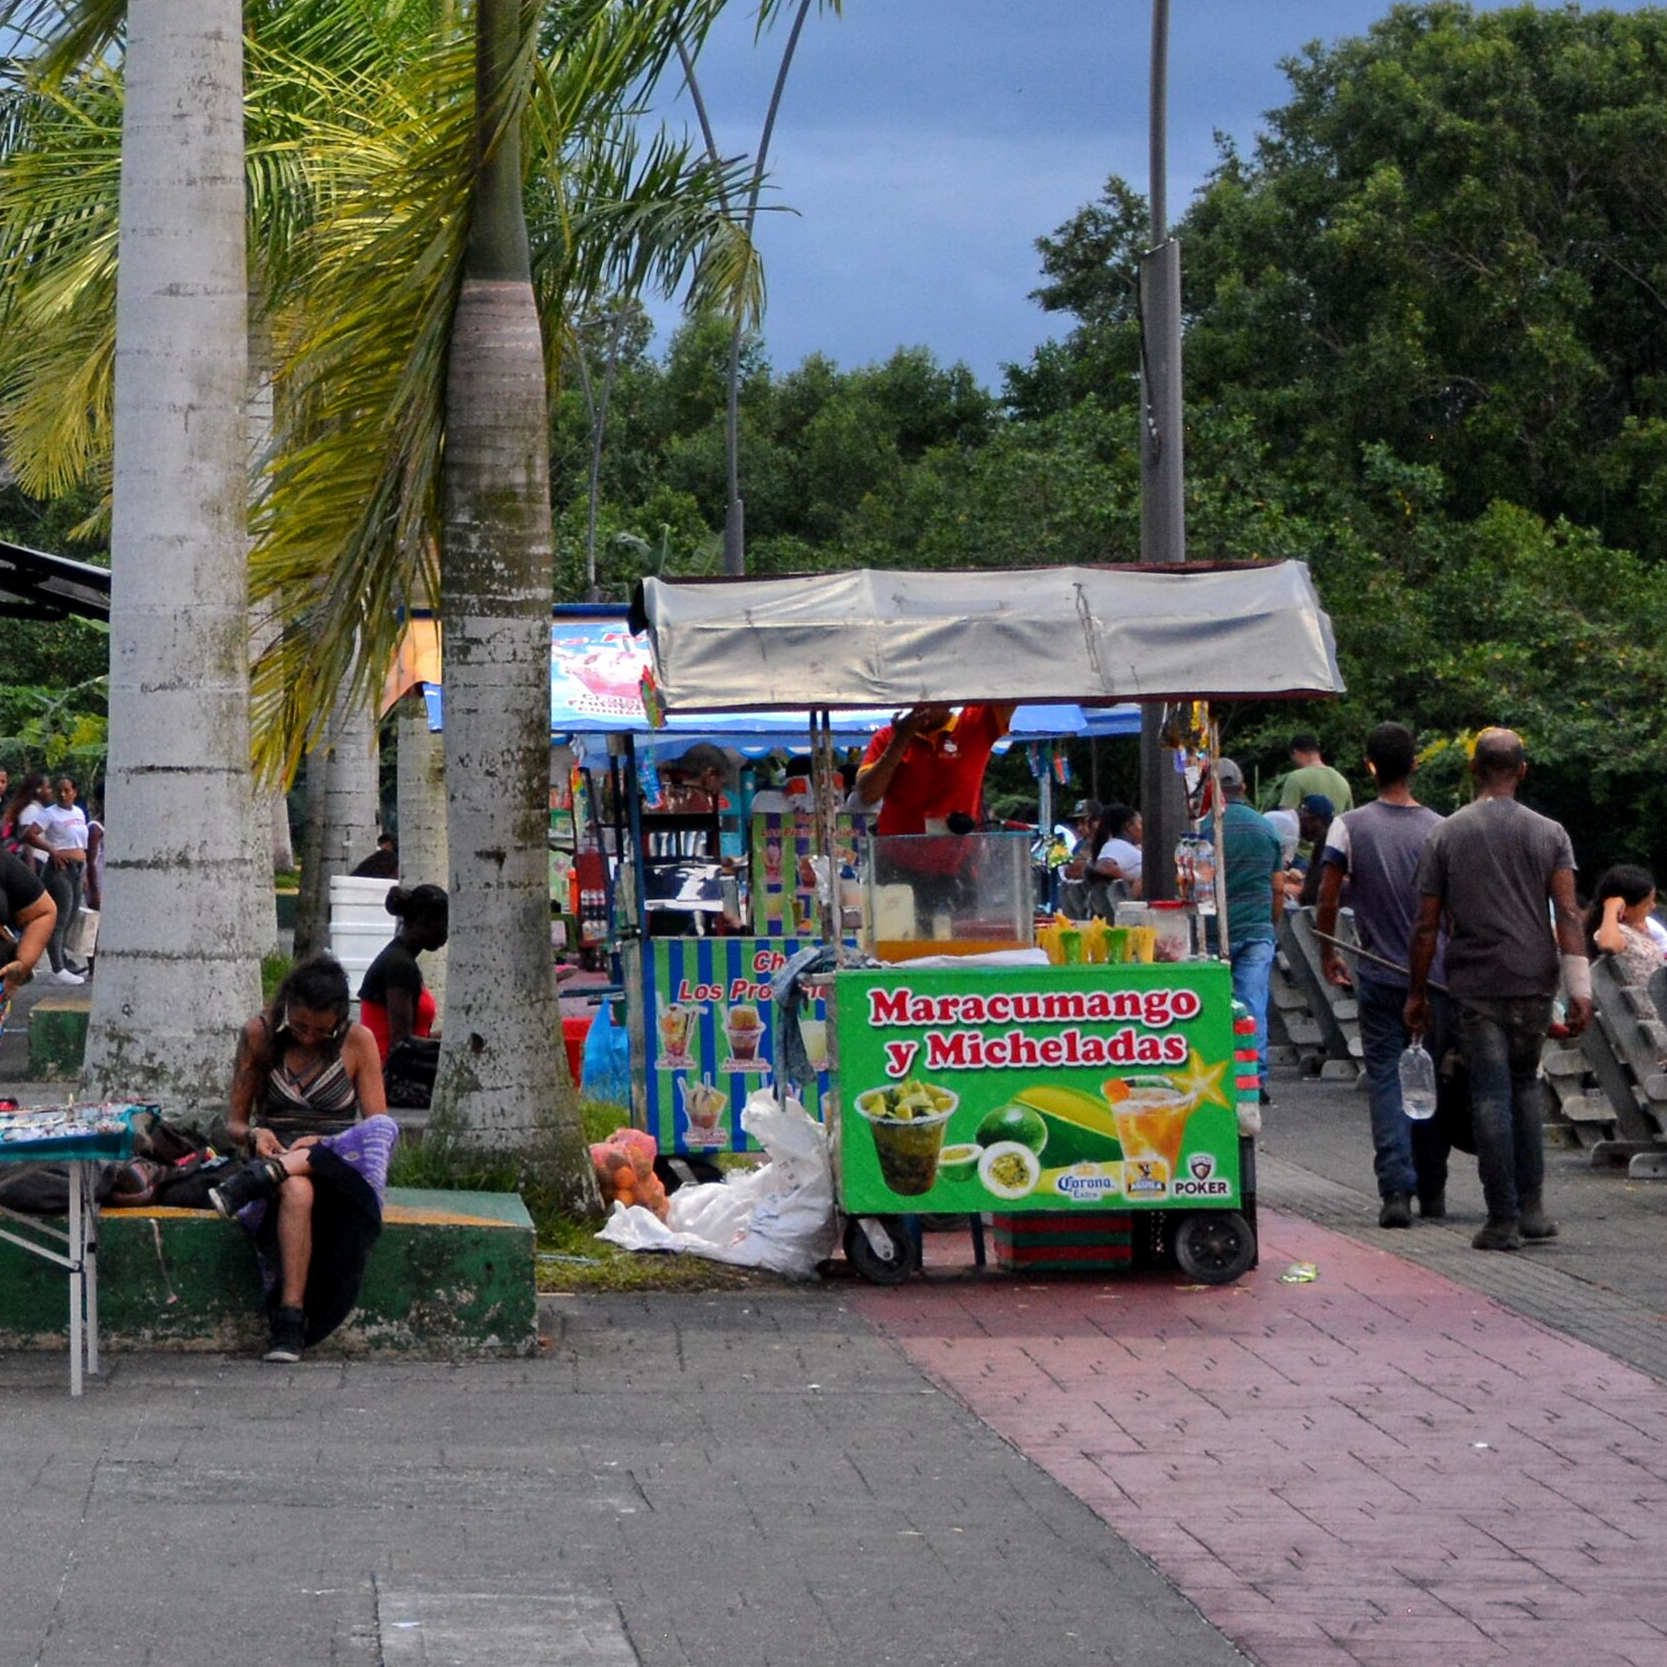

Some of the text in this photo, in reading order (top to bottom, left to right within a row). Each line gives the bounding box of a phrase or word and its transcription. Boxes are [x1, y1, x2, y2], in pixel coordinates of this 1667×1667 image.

[678, 980, 723, 1001] Los
[869, 989, 1199, 1025] Maracumango
[886, 1029, 1187, 1075] y Micheladas
[1058, 1175, 1112, 1192] Corona
[1175, 1182, 1227, 1194] POKER
